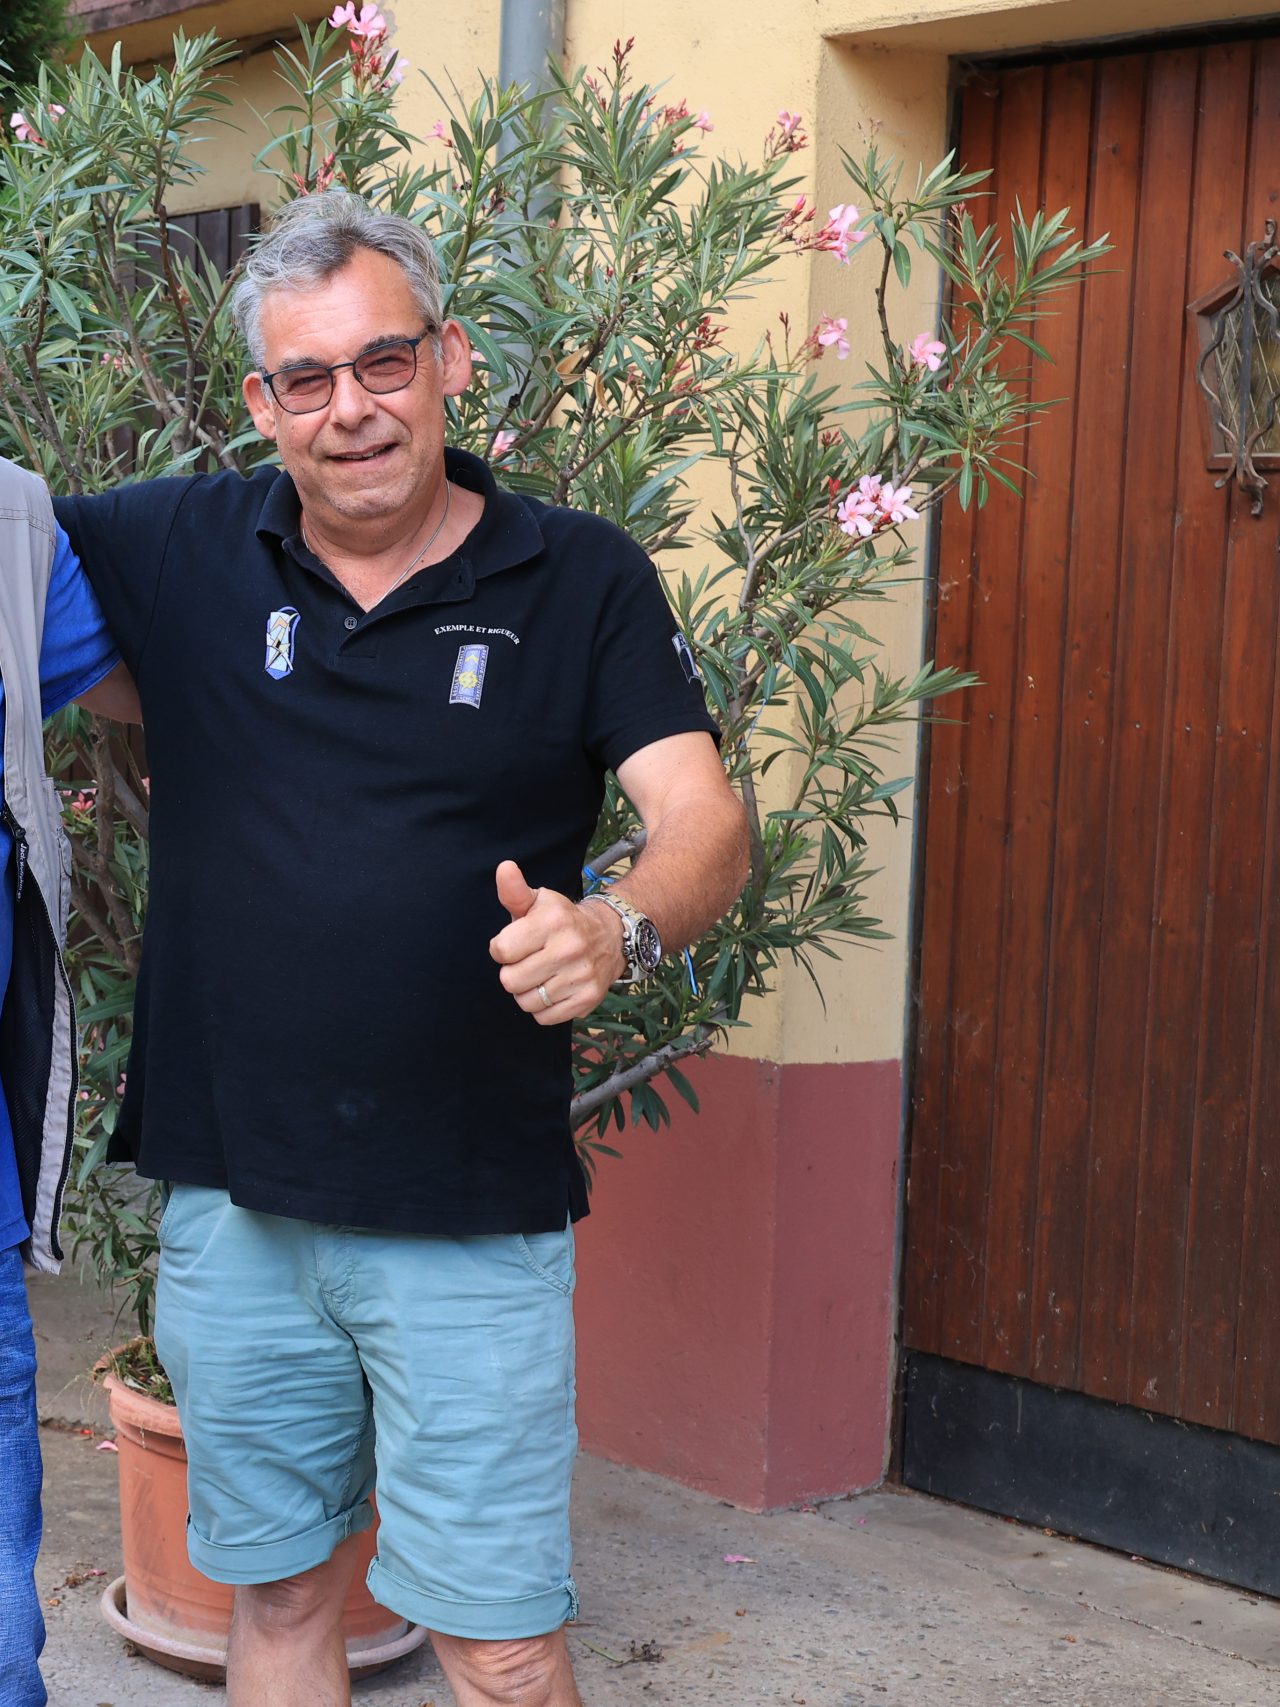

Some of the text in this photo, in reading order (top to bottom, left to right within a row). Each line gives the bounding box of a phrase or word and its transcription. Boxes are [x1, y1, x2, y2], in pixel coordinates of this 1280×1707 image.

[434, 624, 520, 645] EXEMPLE ET RIGUEUR
